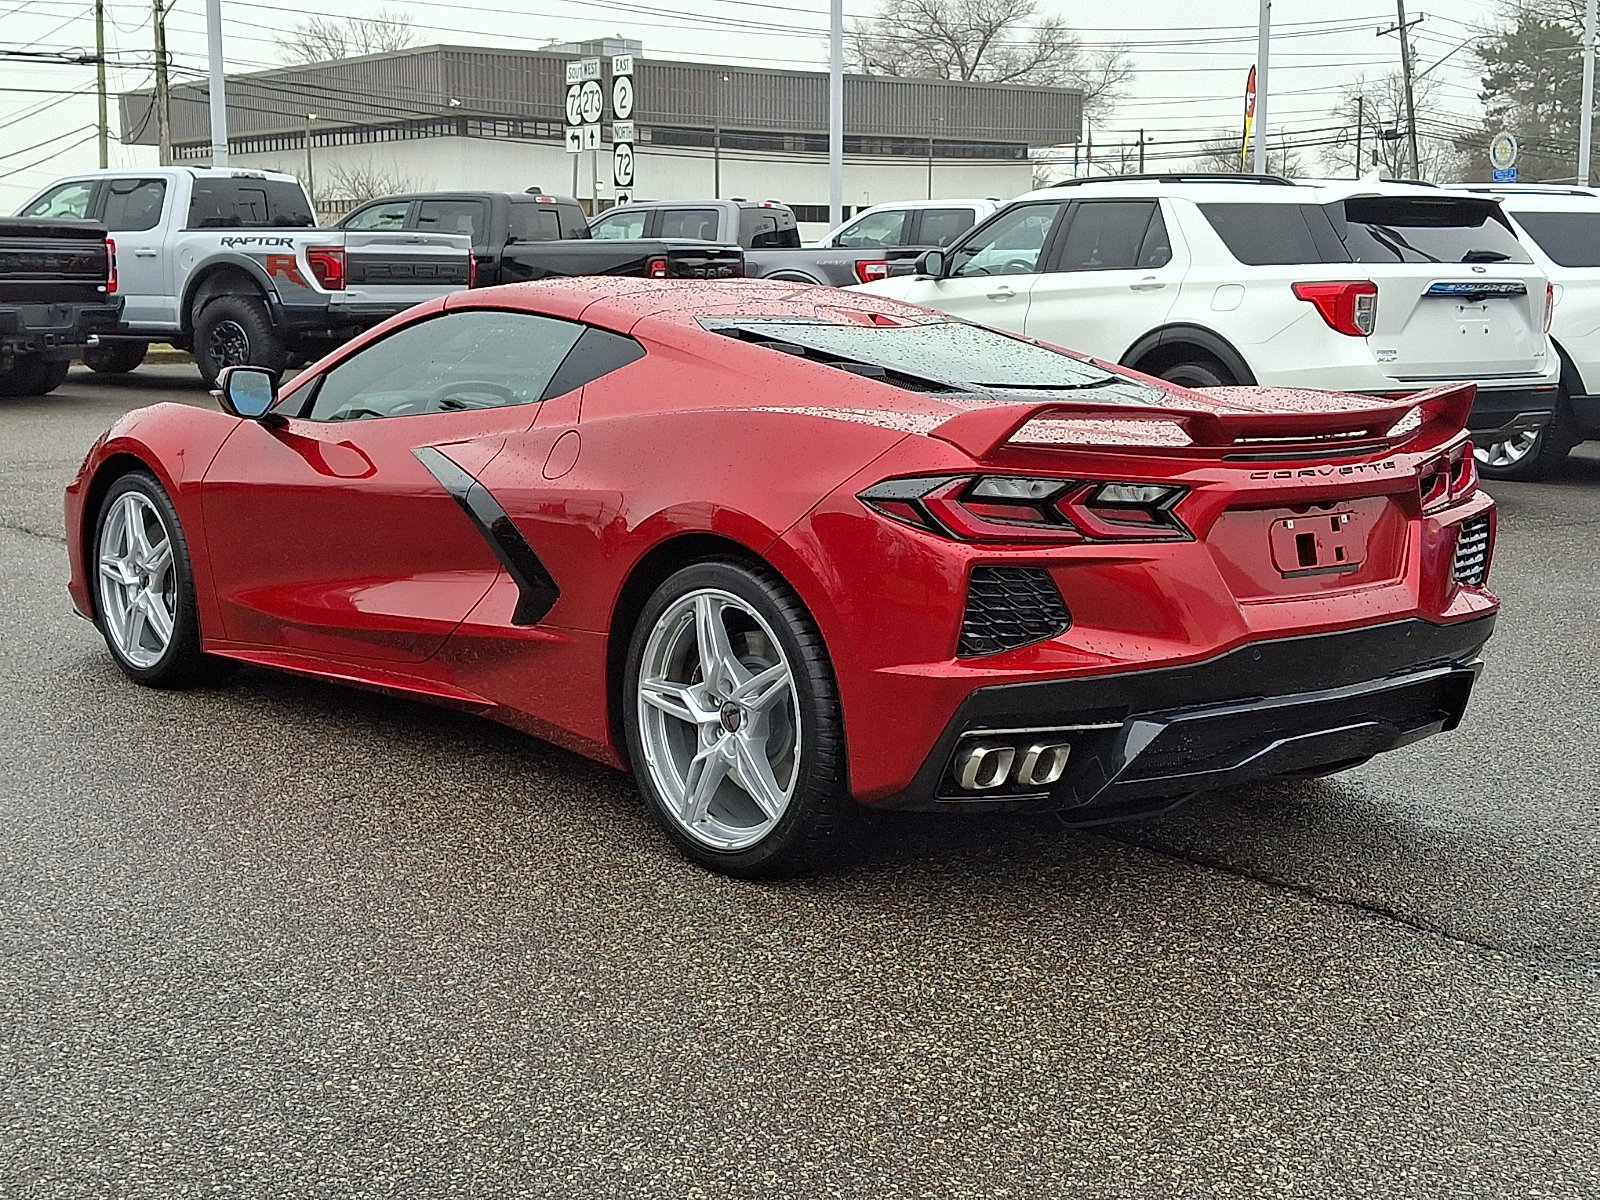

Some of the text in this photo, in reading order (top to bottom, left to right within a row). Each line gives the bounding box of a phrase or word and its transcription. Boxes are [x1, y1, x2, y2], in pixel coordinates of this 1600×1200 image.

[584, 62, 598, 75] WEST
[615, 58, 630, 72] EAST
[568, 67, 582, 80] SOUT
[583, 90, 601, 113] 273
[619, 86, 627, 109] 2
[569, 94, 581, 116] 72
[614, 126, 633, 139] NORTH
[616, 154, 631, 176] 72
[220, 237, 295, 250] RAPTOR
[1447, 284, 1515, 292] EXPLORER
[1250, 460, 1396, 480] CORVETTE
